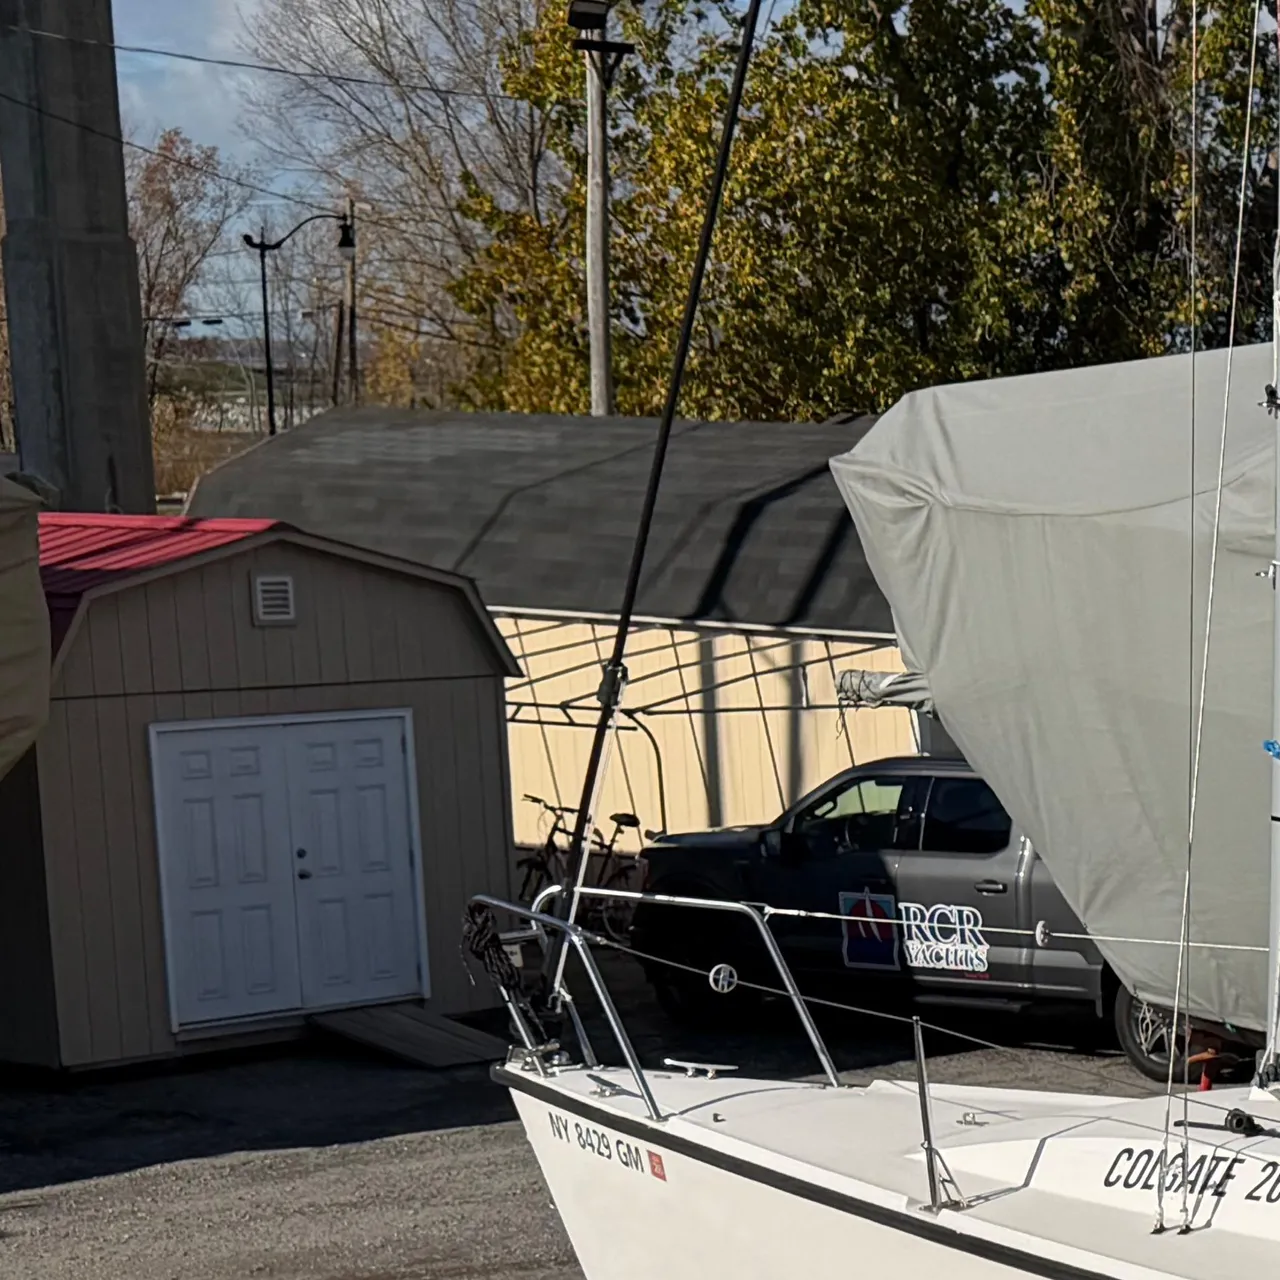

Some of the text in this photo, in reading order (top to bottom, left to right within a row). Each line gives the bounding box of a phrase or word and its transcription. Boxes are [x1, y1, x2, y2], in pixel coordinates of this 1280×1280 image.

[898, 902, 990, 948] RCR
[904, 942, 988, 971] YACHTS
[548, 1112, 571, 1143] NY
[574, 1122, 612, 1160] 8429
[616, 1139, 645, 1173] GM
[1104, 1147, 1245, 1196] COLGATE
